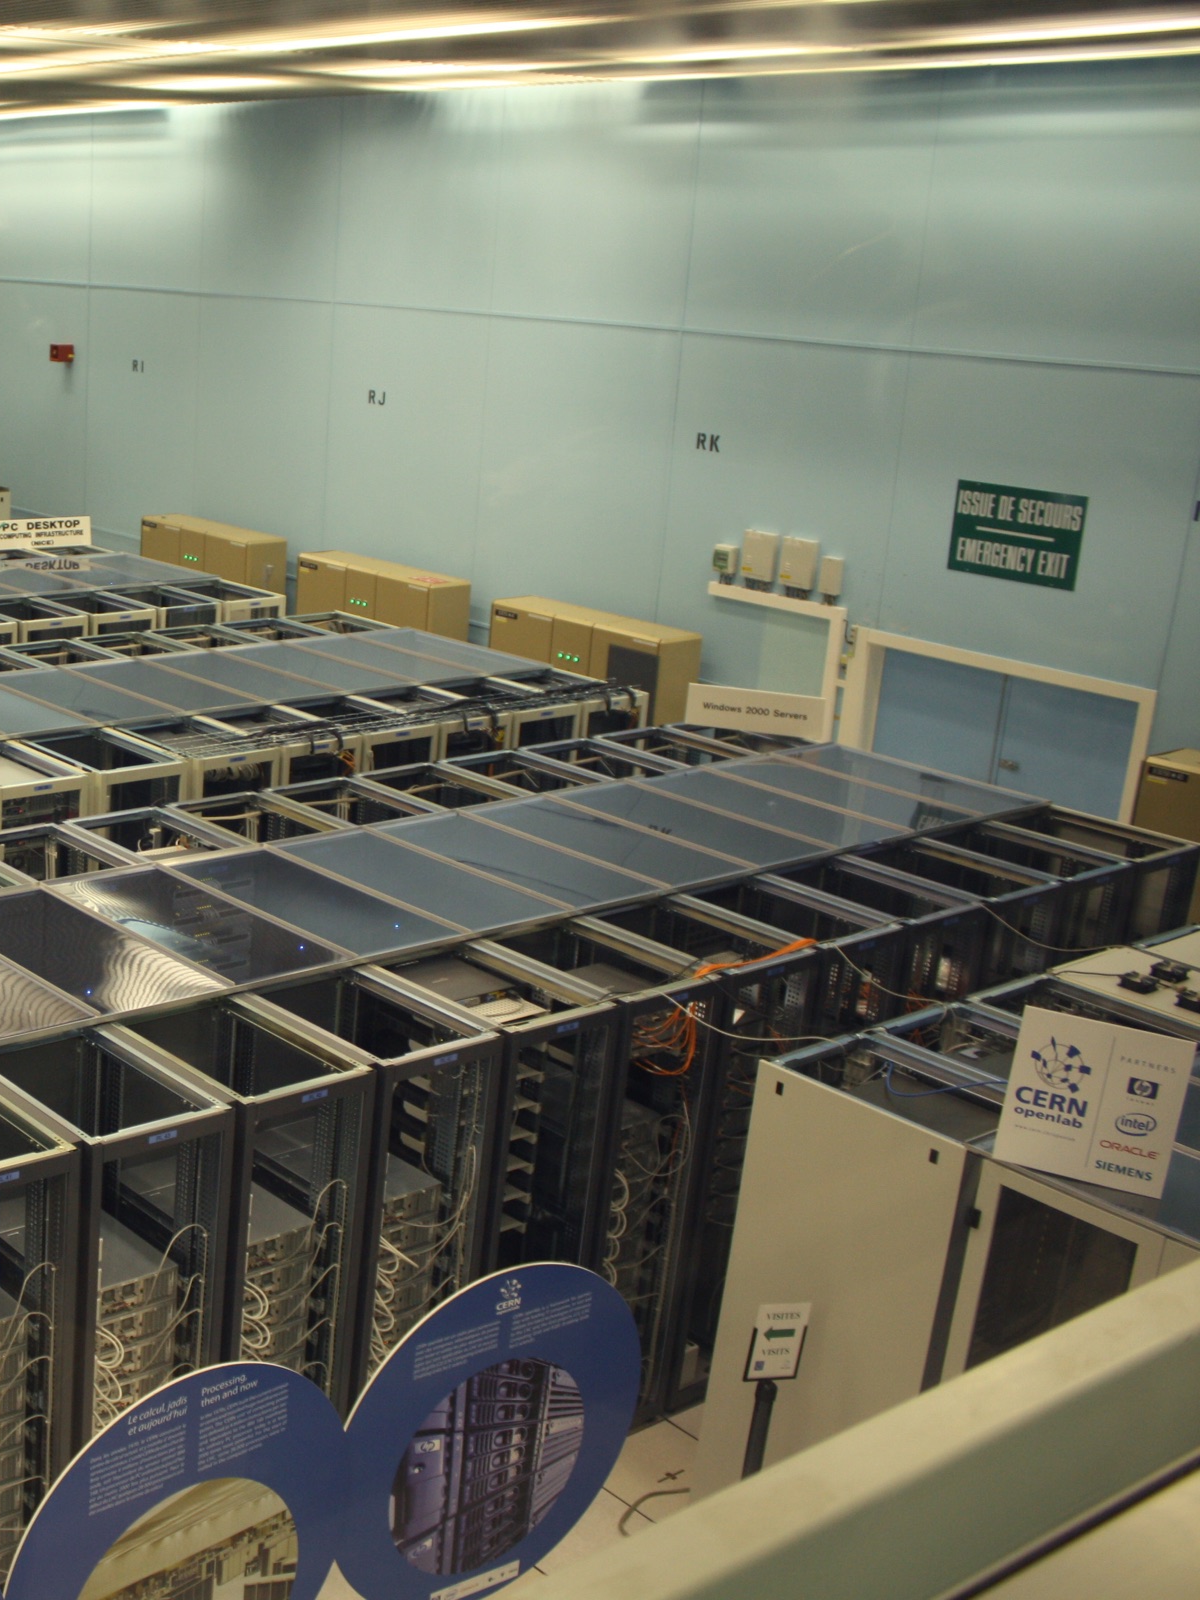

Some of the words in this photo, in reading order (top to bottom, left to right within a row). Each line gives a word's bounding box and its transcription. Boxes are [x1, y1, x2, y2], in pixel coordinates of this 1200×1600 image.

[368, 389, 386, 406] RJ
[695, 432, 721, 453] RK
[957, 489, 996, 519] ISSUE
[997, 494, 1016, 521] DE
[1017, 497, 1084, 532] SECOURS
[2, 522, 18, 531] PC
[26, 519, 81, 530] DESKTOP
[956, 536, 1036, 574] EMERGENCY
[1037, 550, 1070, 580] EXIT
[702, 701, 743, 715] Windows
[745, 705, 771, 718] 2000
[773, 708, 808, 721] Servers
[1120, 1055, 1177, 1074] PARTNERS
[1015, 1086, 1089, 1118] CERN
[1013, 1105, 1084, 1129] openlab
[1099, 1139, 1159, 1160] ORACLE
[1094, 1159, 1153, 1182] SIEMENS
[496, 1297, 522, 1311] CERN
[766, 1312, 801, 1320] VISITES
[762, 1347, 791, 1356] VISITS
[200, 1394, 221, 1408] then
[222, 1386, 239, 1400] and
[240, 1379, 259, 1393] now
[201, 1374, 248, 1396] Processing,
[127, 1413, 138, 1426] Le
[139, 1402, 166, 1421] calcul,
[166, 1395, 188, 1416] jadis
[127, 1425, 138, 1436] et
[138, 1407, 188, 1432] aujourd'hui
